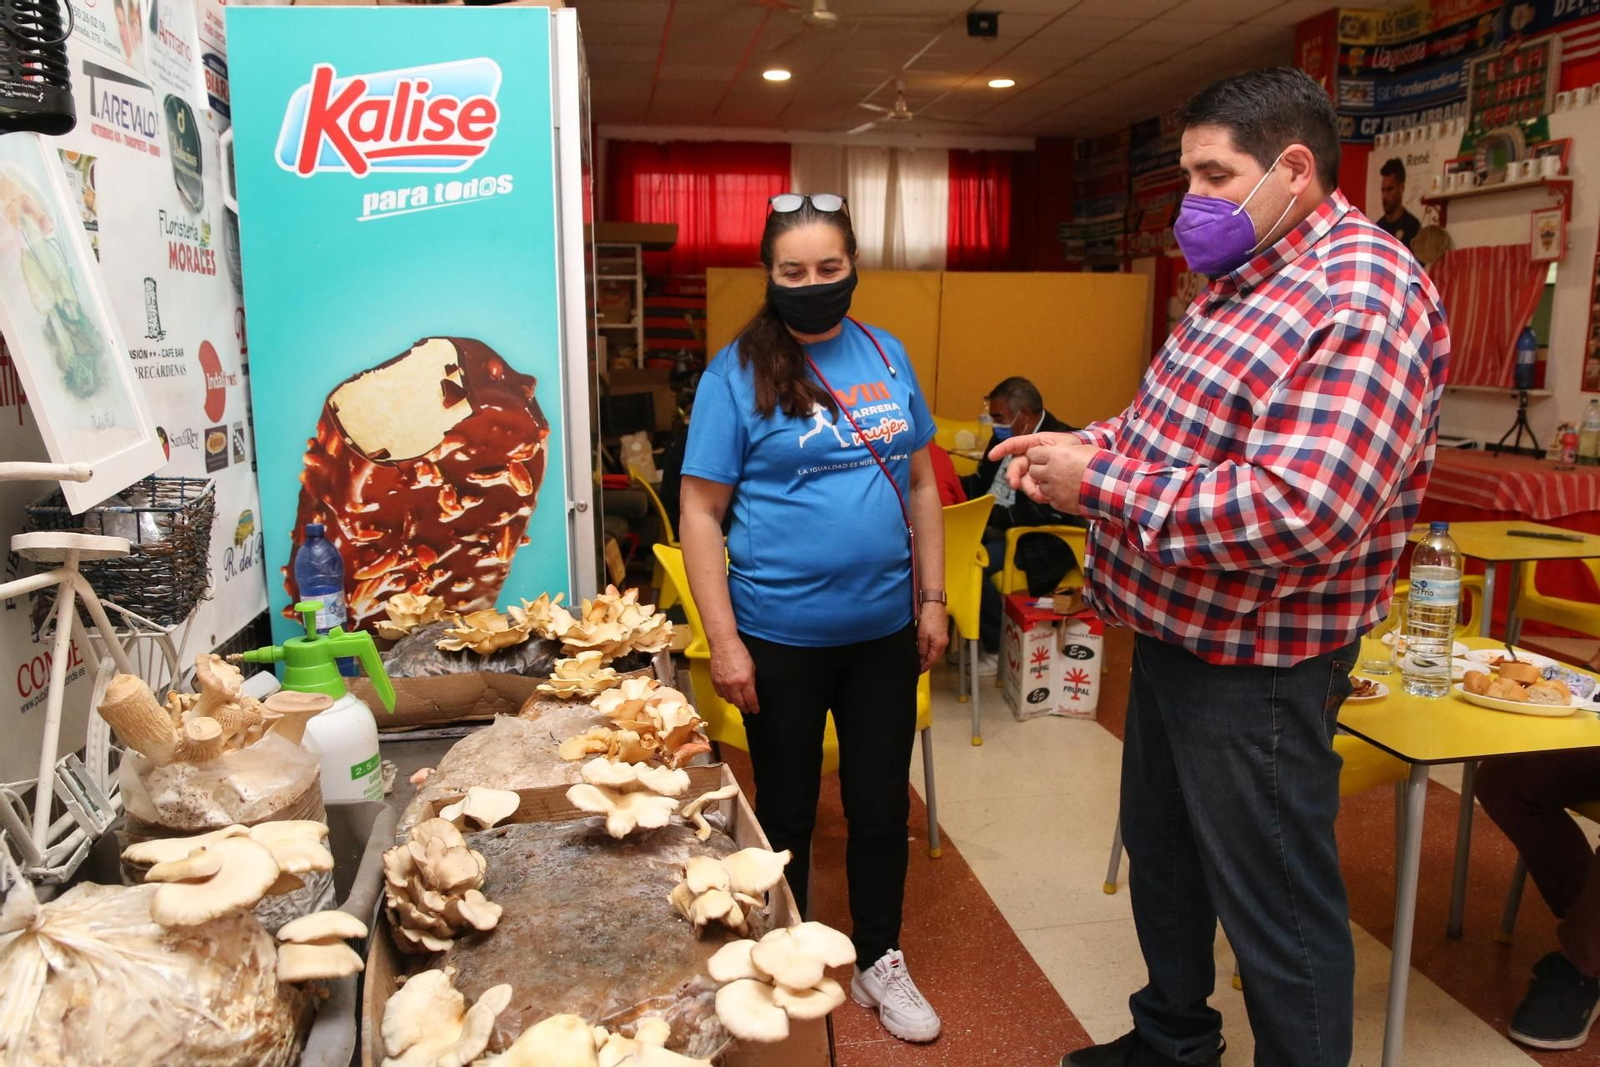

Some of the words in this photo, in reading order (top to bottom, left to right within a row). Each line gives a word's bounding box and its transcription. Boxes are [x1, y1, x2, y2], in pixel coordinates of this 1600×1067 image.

[298, 66, 497, 176] Kalise
[362, 185, 429, 217] para
[168, 240, 216, 277] MORALES
[128, 346, 148, 360] NSIÓN
[809, 462, 848, 473] IGUALDAD
